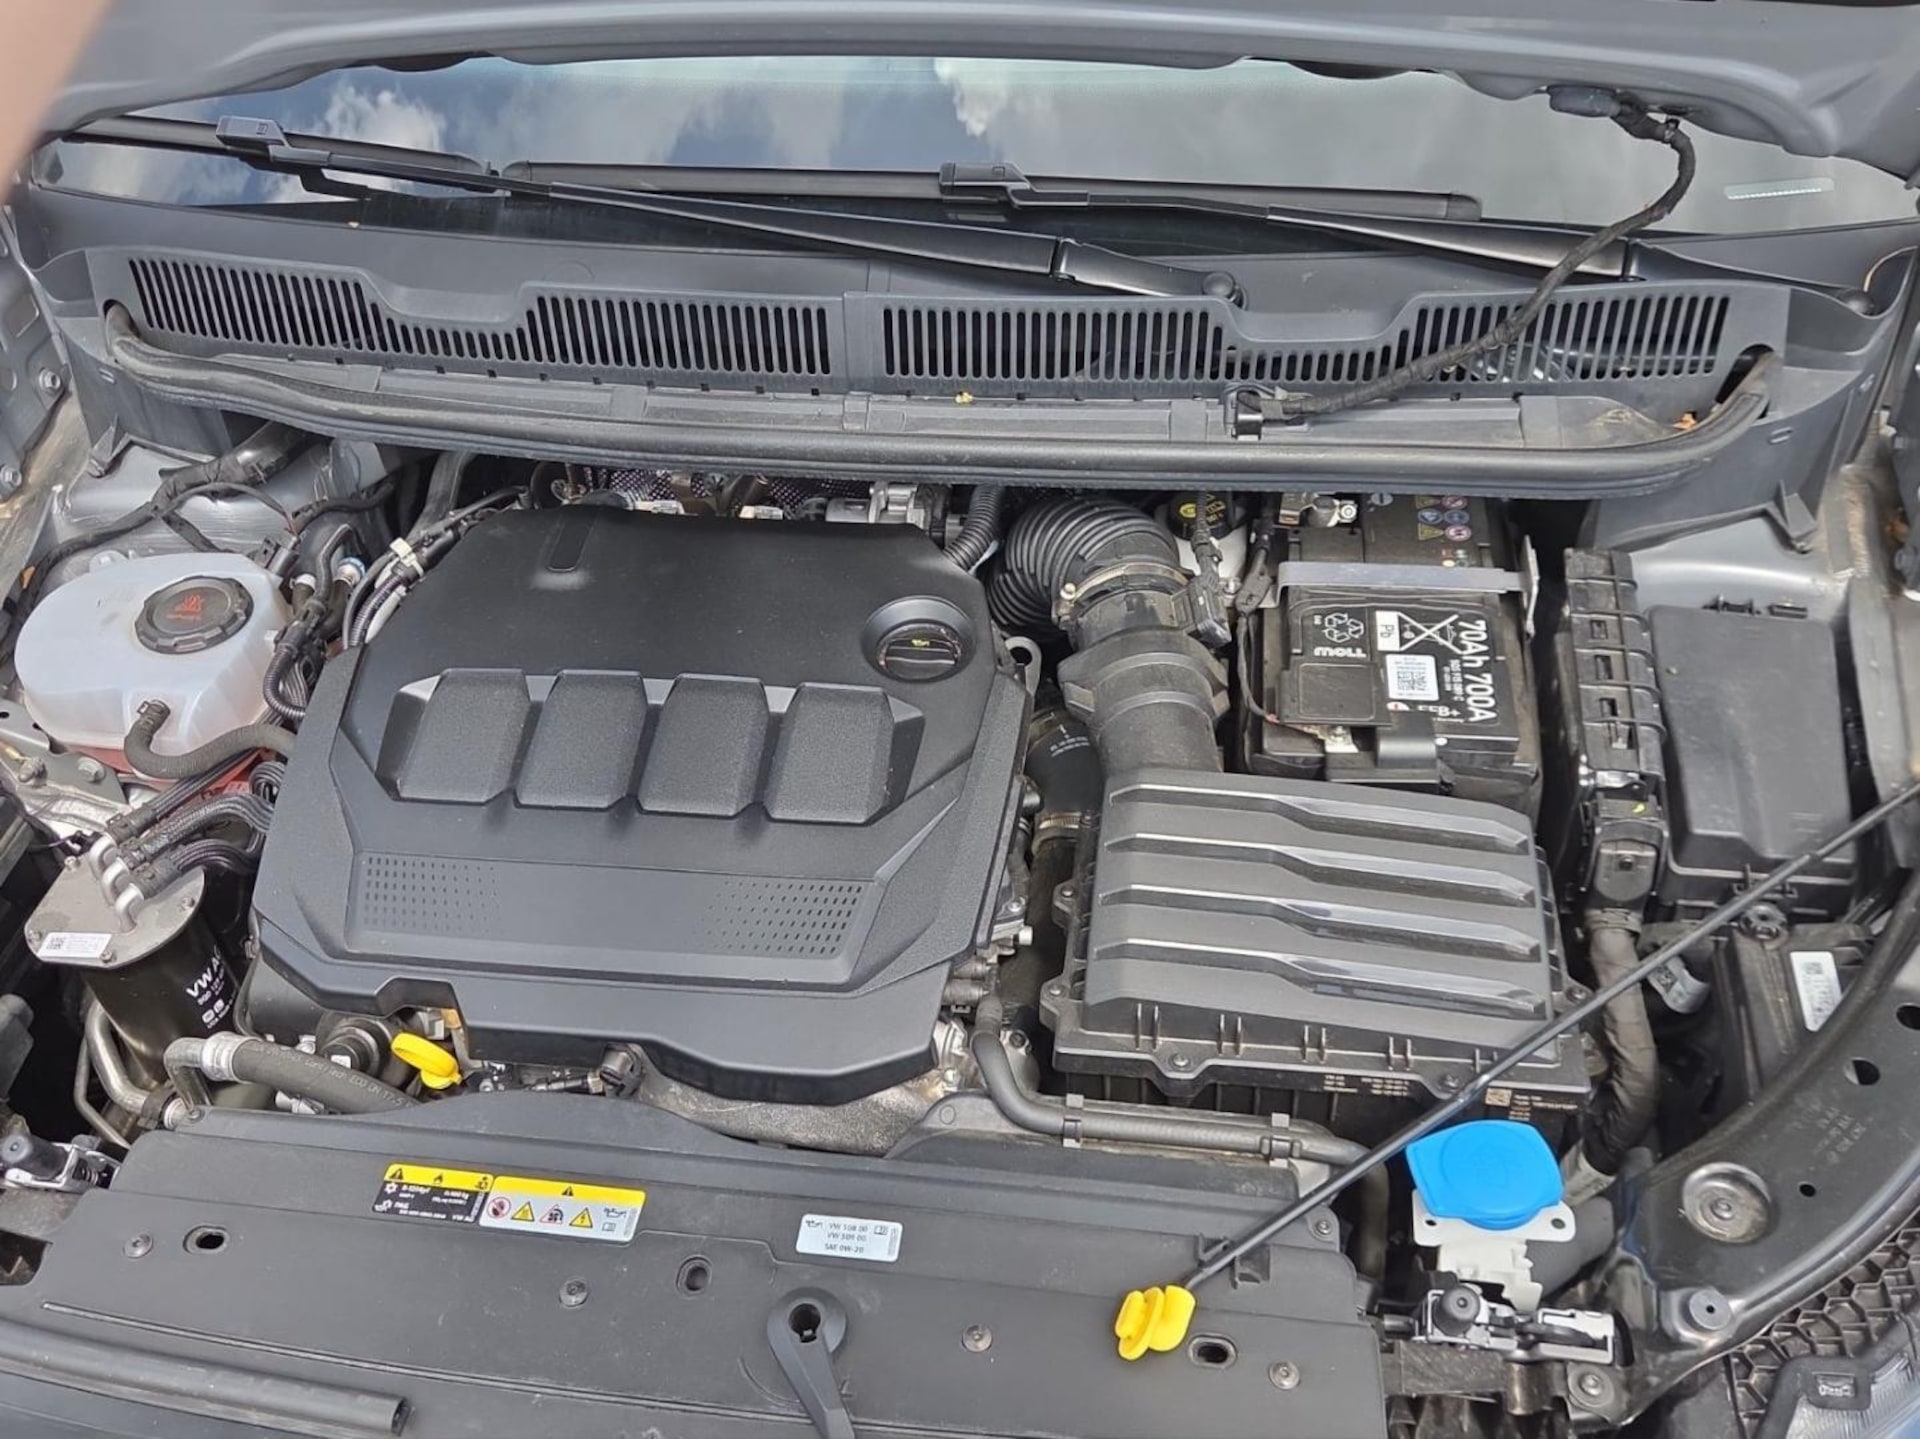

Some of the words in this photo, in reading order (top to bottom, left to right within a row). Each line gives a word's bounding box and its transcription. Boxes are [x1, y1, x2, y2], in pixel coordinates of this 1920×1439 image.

[1380, 624, 1392, 639] Pb
[1458, 619, 1490, 668] 70Ah
[1464, 673, 1498, 722] 700A
[185, 967, 213, 998] VW
[827, 1232, 840, 1240] VW
